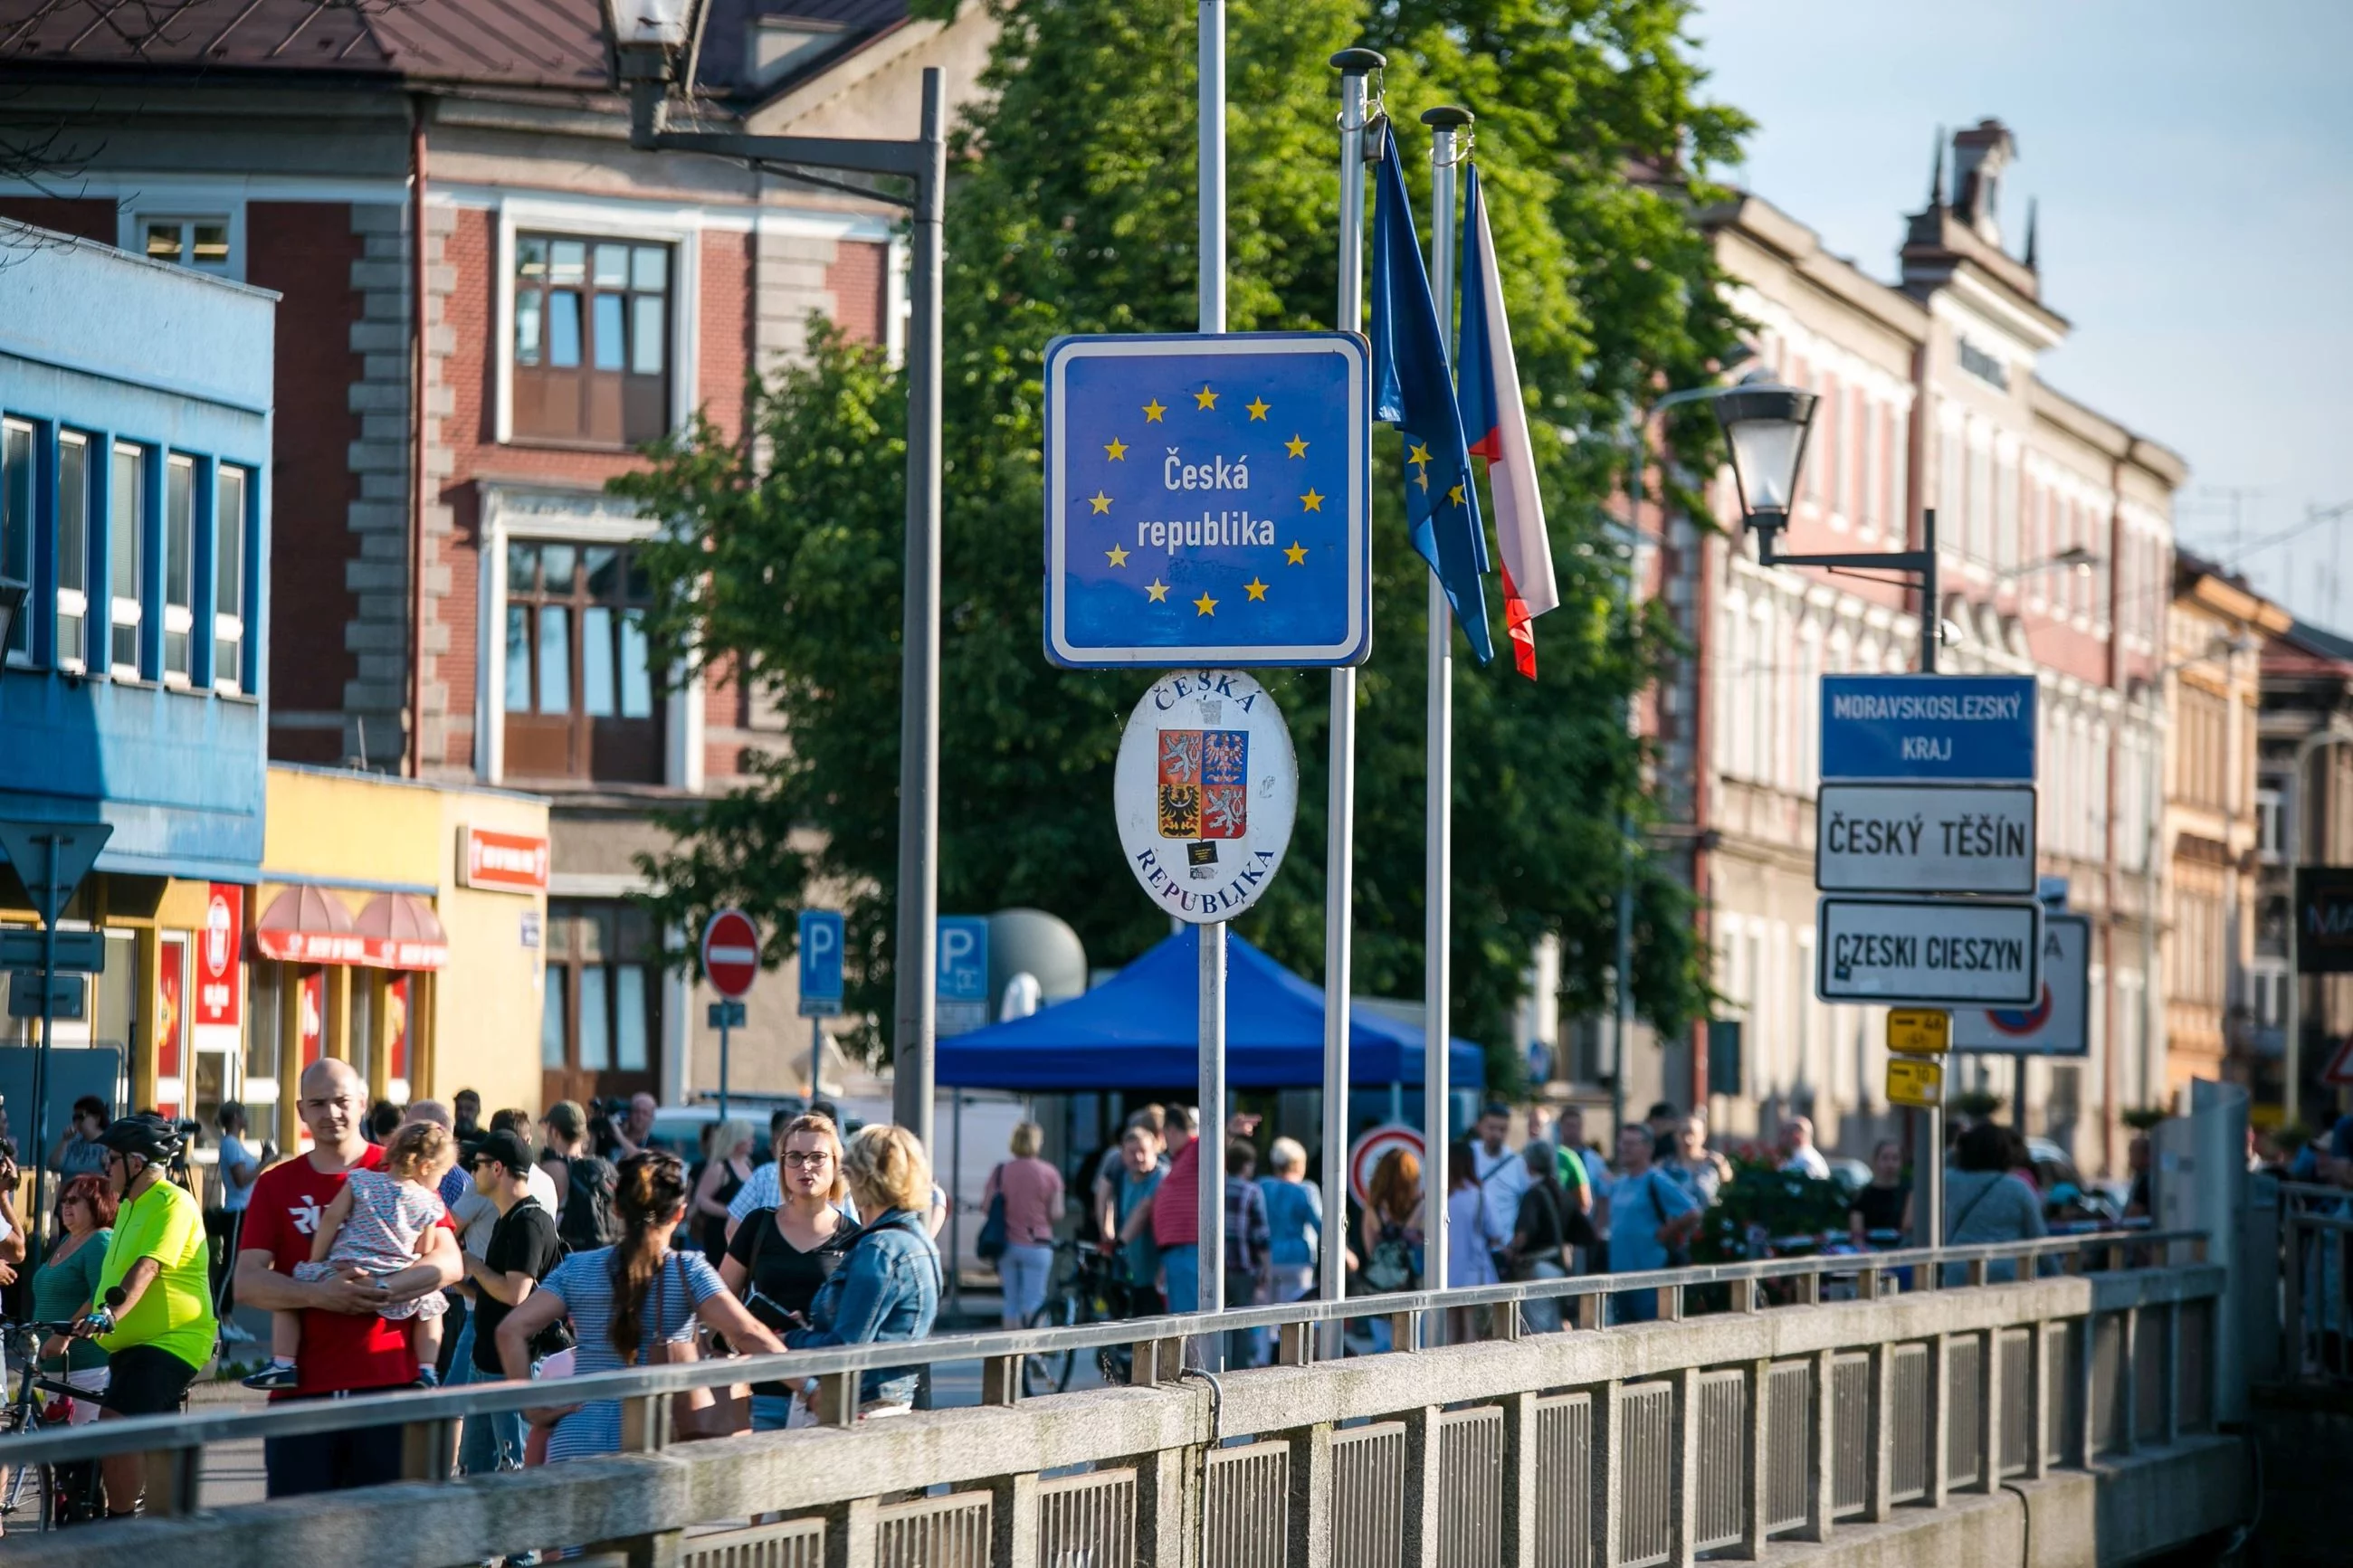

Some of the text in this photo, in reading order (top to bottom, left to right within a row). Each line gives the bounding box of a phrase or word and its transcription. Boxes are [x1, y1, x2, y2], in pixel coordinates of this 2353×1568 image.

[1165, 447, 1249, 489] Česká
[1138, 511, 1275, 556] republika
[1155, 670, 1262, 714] ČESKÁ
[1834, 691, 2022, 720] MORAVSKOSLEZSKÝ
[1902, 736, 1952, 761] KRAJ
[1828, 811, 2025, 857] ČESKÝ TĚŠÍN
[1137, 848, 1274, 914] REPUBLIKA
[1835, 933, 2023, 972] CZESKI CIESZYN
